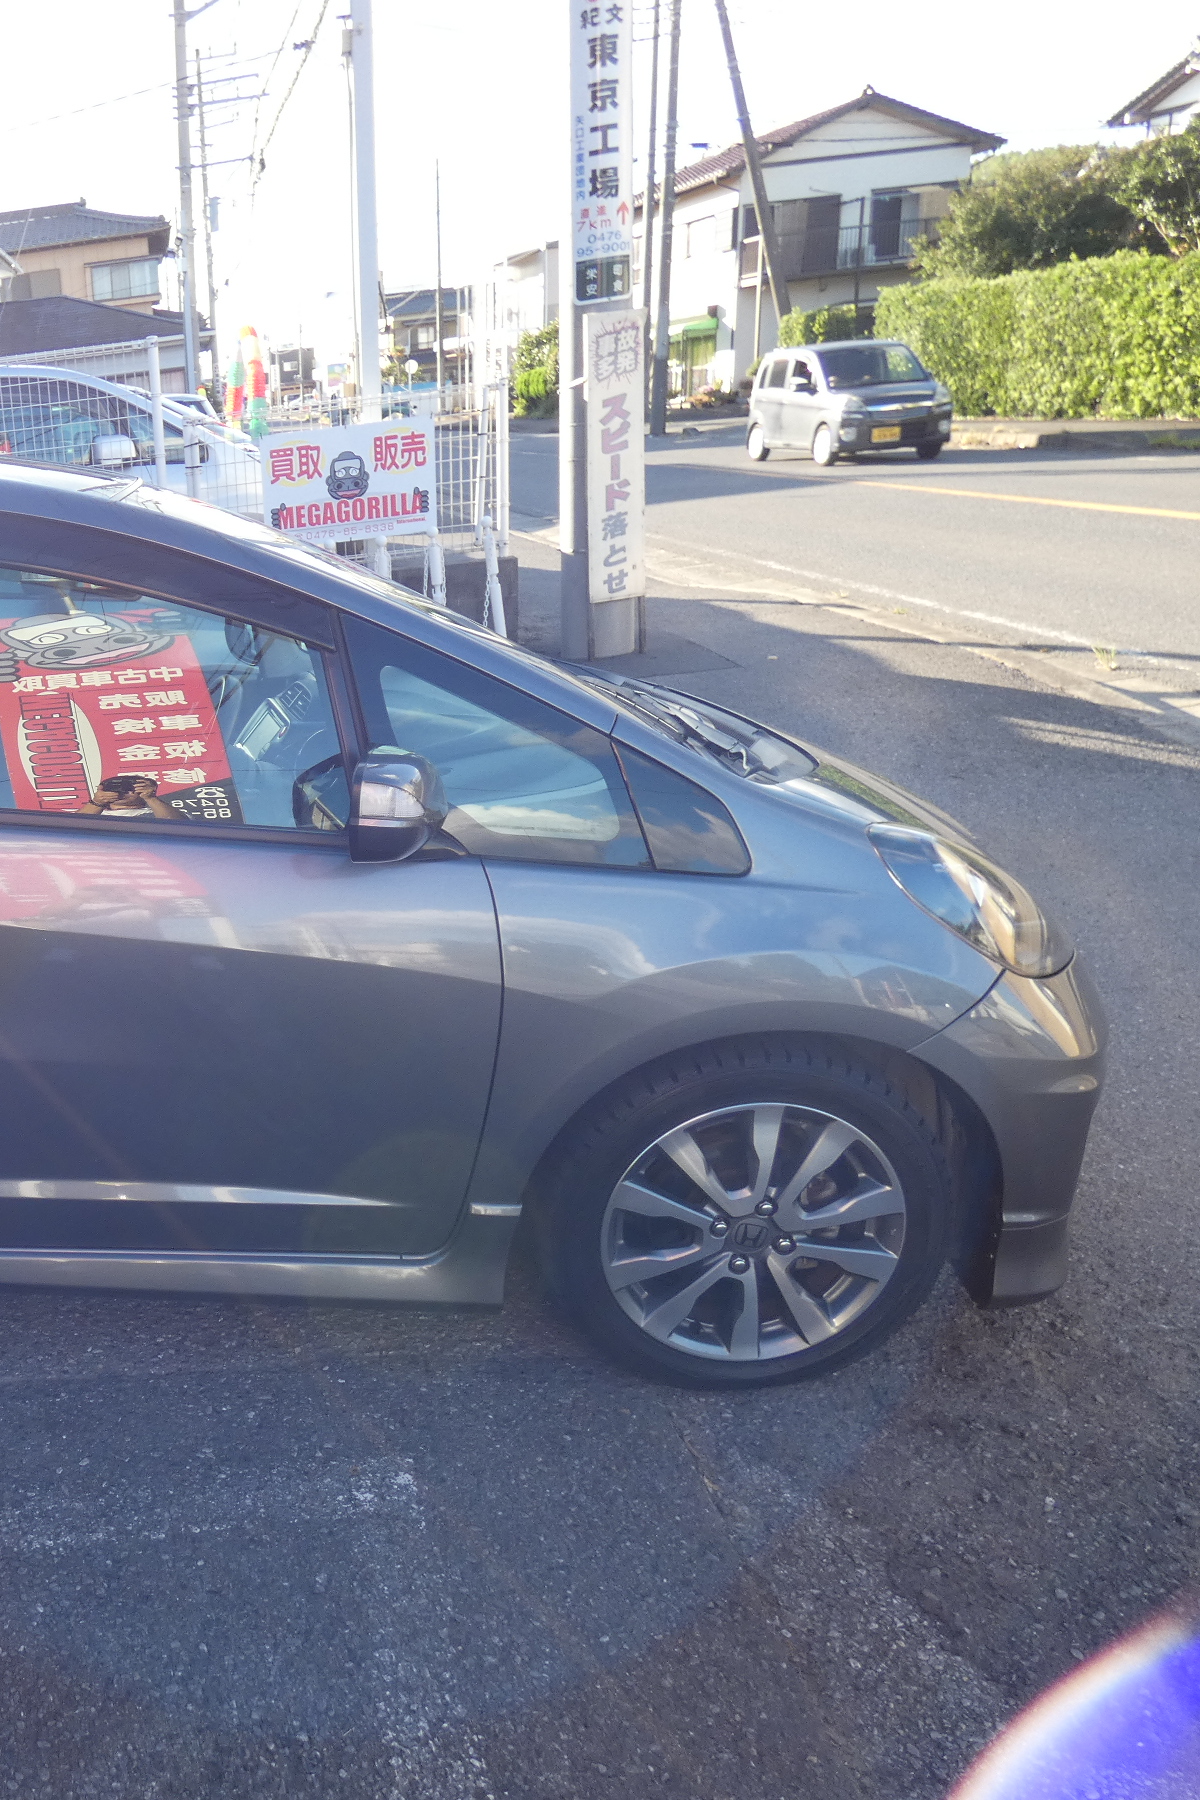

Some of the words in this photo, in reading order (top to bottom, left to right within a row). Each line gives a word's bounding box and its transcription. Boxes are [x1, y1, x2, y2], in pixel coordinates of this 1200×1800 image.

[587, 33, 620, 200] 東京工場
[576, 241, 630, 257] 95-9001
[587, 230, 622, 244] 0476
[269, 444, 323, 485] 買取
[373, 431, 427, 473] 販売
[278, 491, 422, 530] MEGAGORILLA
[599, 392, 632, 595] スピード落とせ
